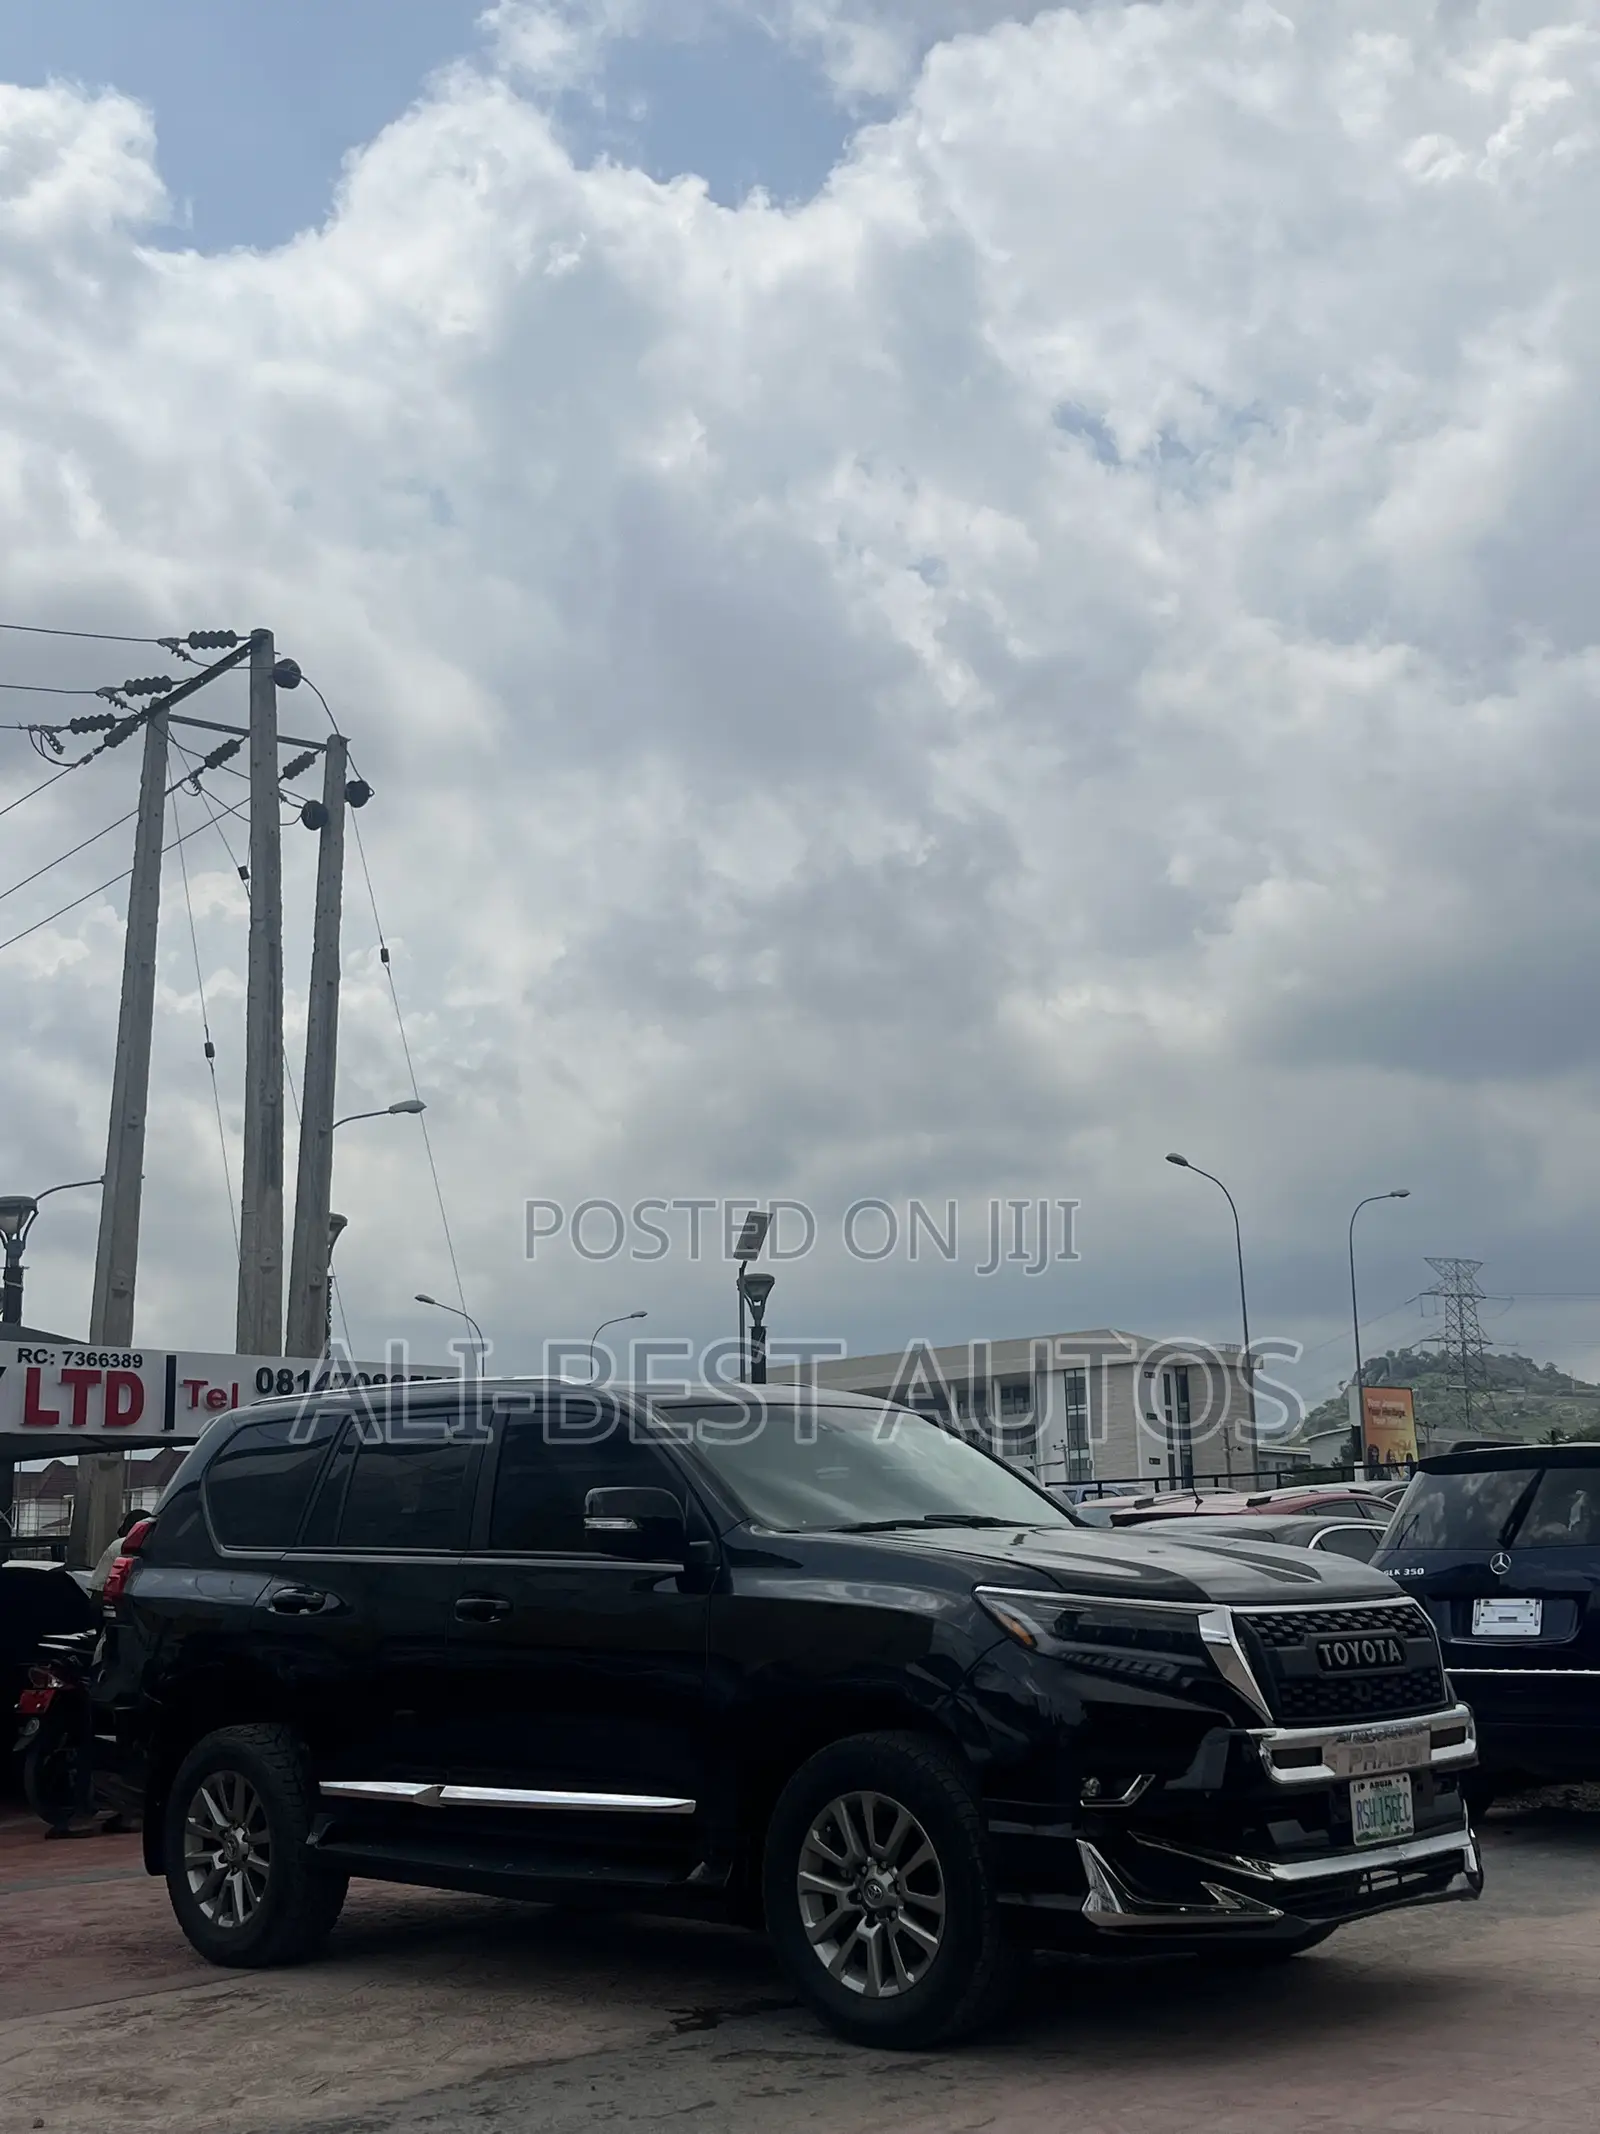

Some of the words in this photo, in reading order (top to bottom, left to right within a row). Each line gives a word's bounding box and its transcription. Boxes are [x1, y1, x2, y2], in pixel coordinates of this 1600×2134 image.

[17, 1347, 56, 1365] RC:
[62, 1351, 143, 1368] 7366389
[23, 1367, 145, 1426] LTD
[182, 1379, 239, 1409] Tel
[1403, 1567, 1425, 1576] 350
[1318, 1639, 1402, 1667] TOYOTA
